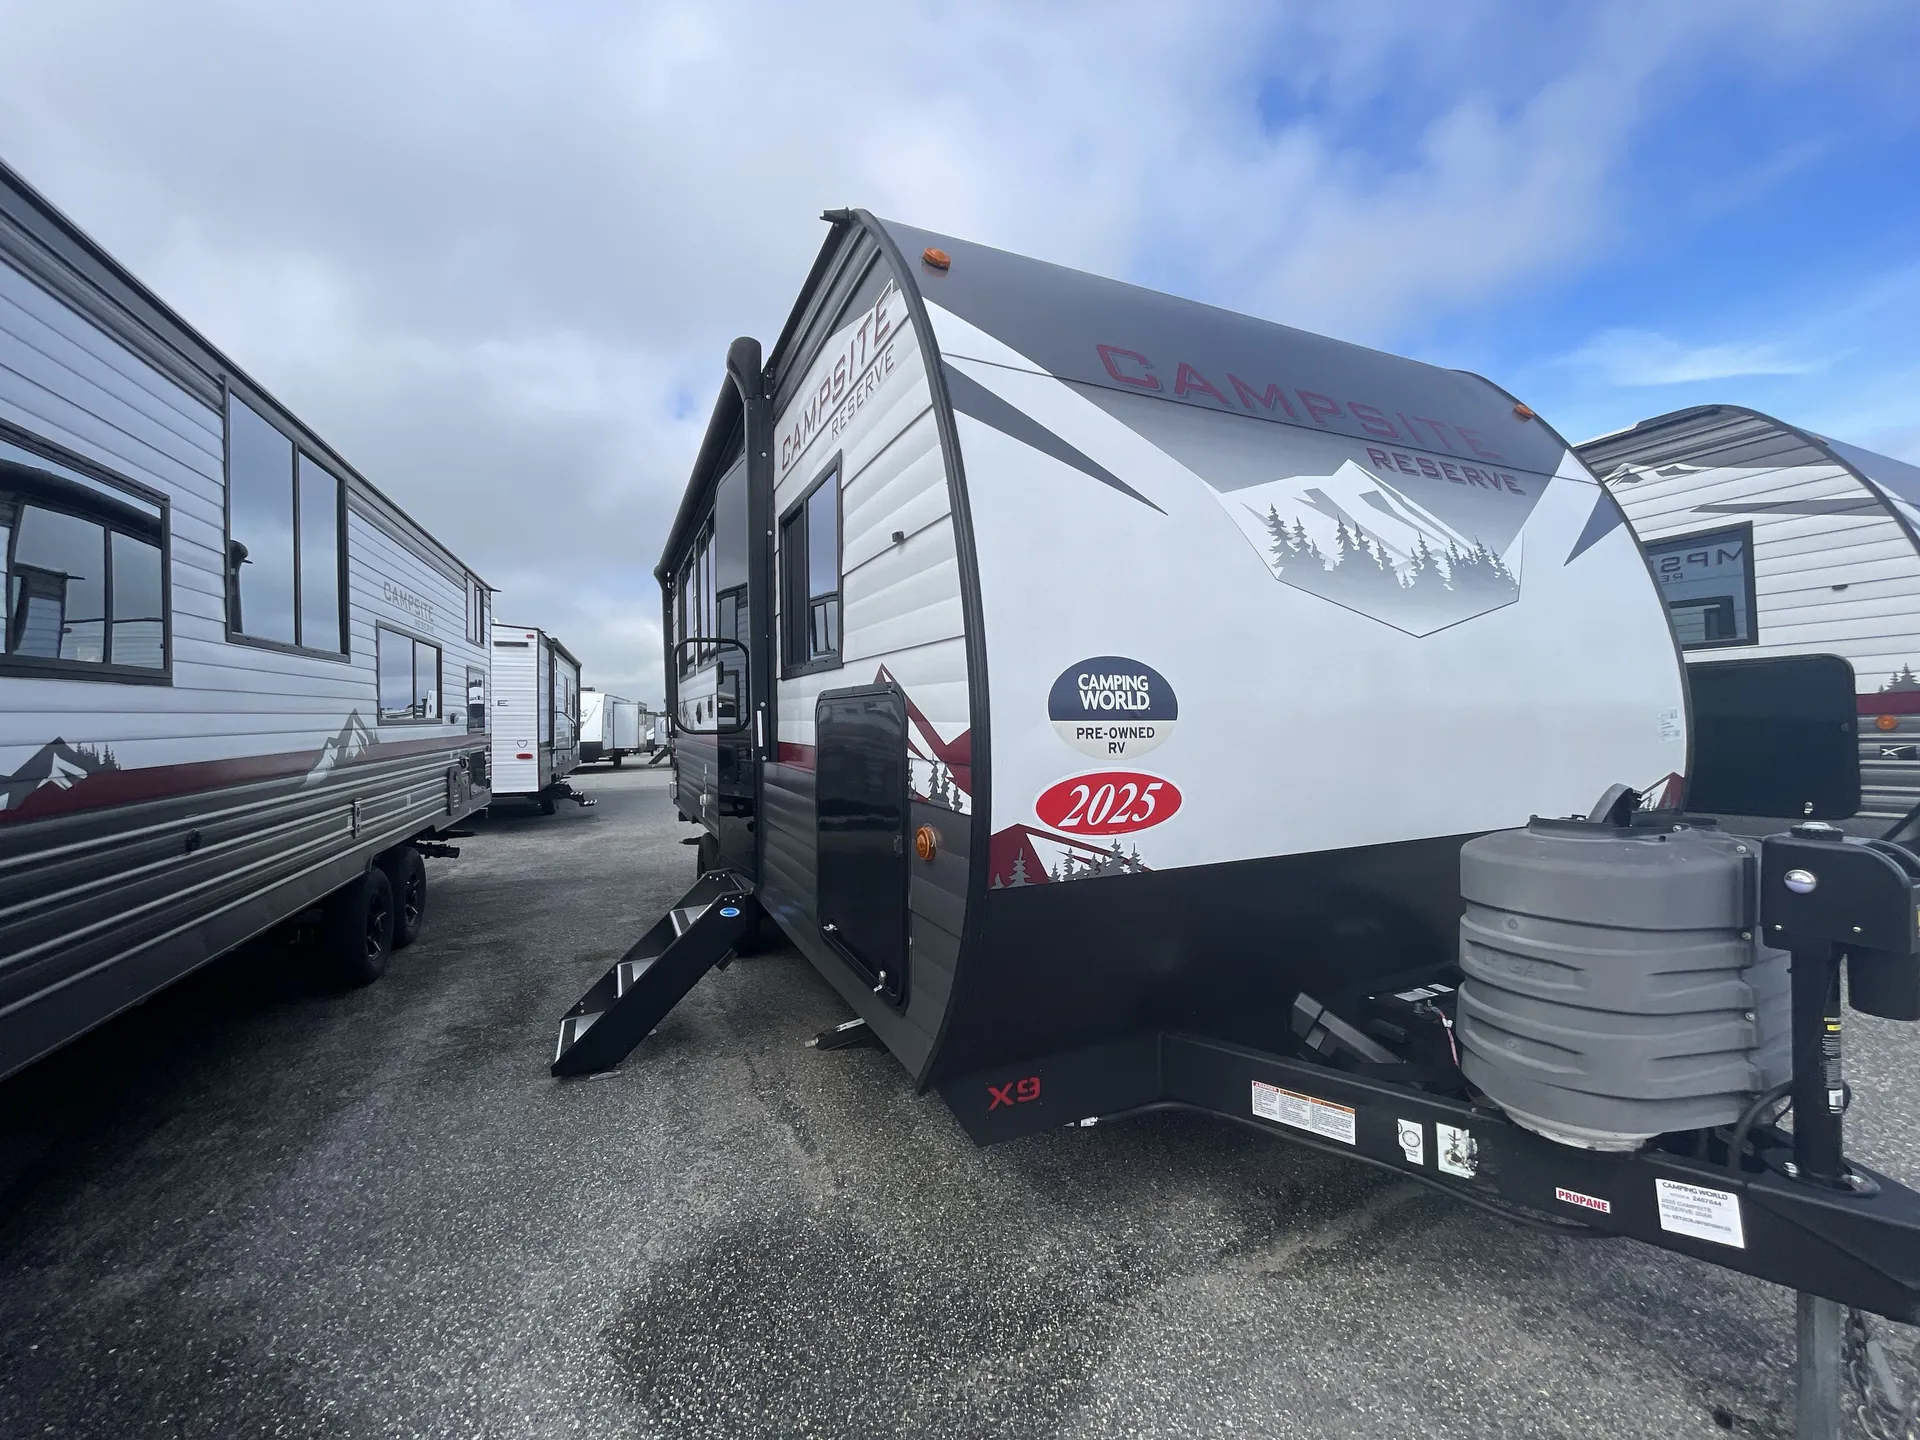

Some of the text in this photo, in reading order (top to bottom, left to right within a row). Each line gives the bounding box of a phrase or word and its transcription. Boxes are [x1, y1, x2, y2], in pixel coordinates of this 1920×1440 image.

[781, 280, 894, 471] CAMPSITE
[831, 344, 895, 440] RESERVE
[1095, 344, 1503, 460] CAMPSITE
[1365, 447, 1527, 496] RESERVE
[383, 581, 434, 622] CAMPSITE
[1077, 673, 1149, 691] CAMPING
[1076, 727, 1155, 739] PRE-OWNED
[1108, 742, 1126, 754] RV
[1057, 782, 1163, 828] 2025
[987, 1076, 1041, 1111] X9
[1558, 1190, 1608, 1212] PROPANE
[1662, 1182, 1697, 1194] CAMPING
[1699, 1189, 1728, 1200] WORLD
